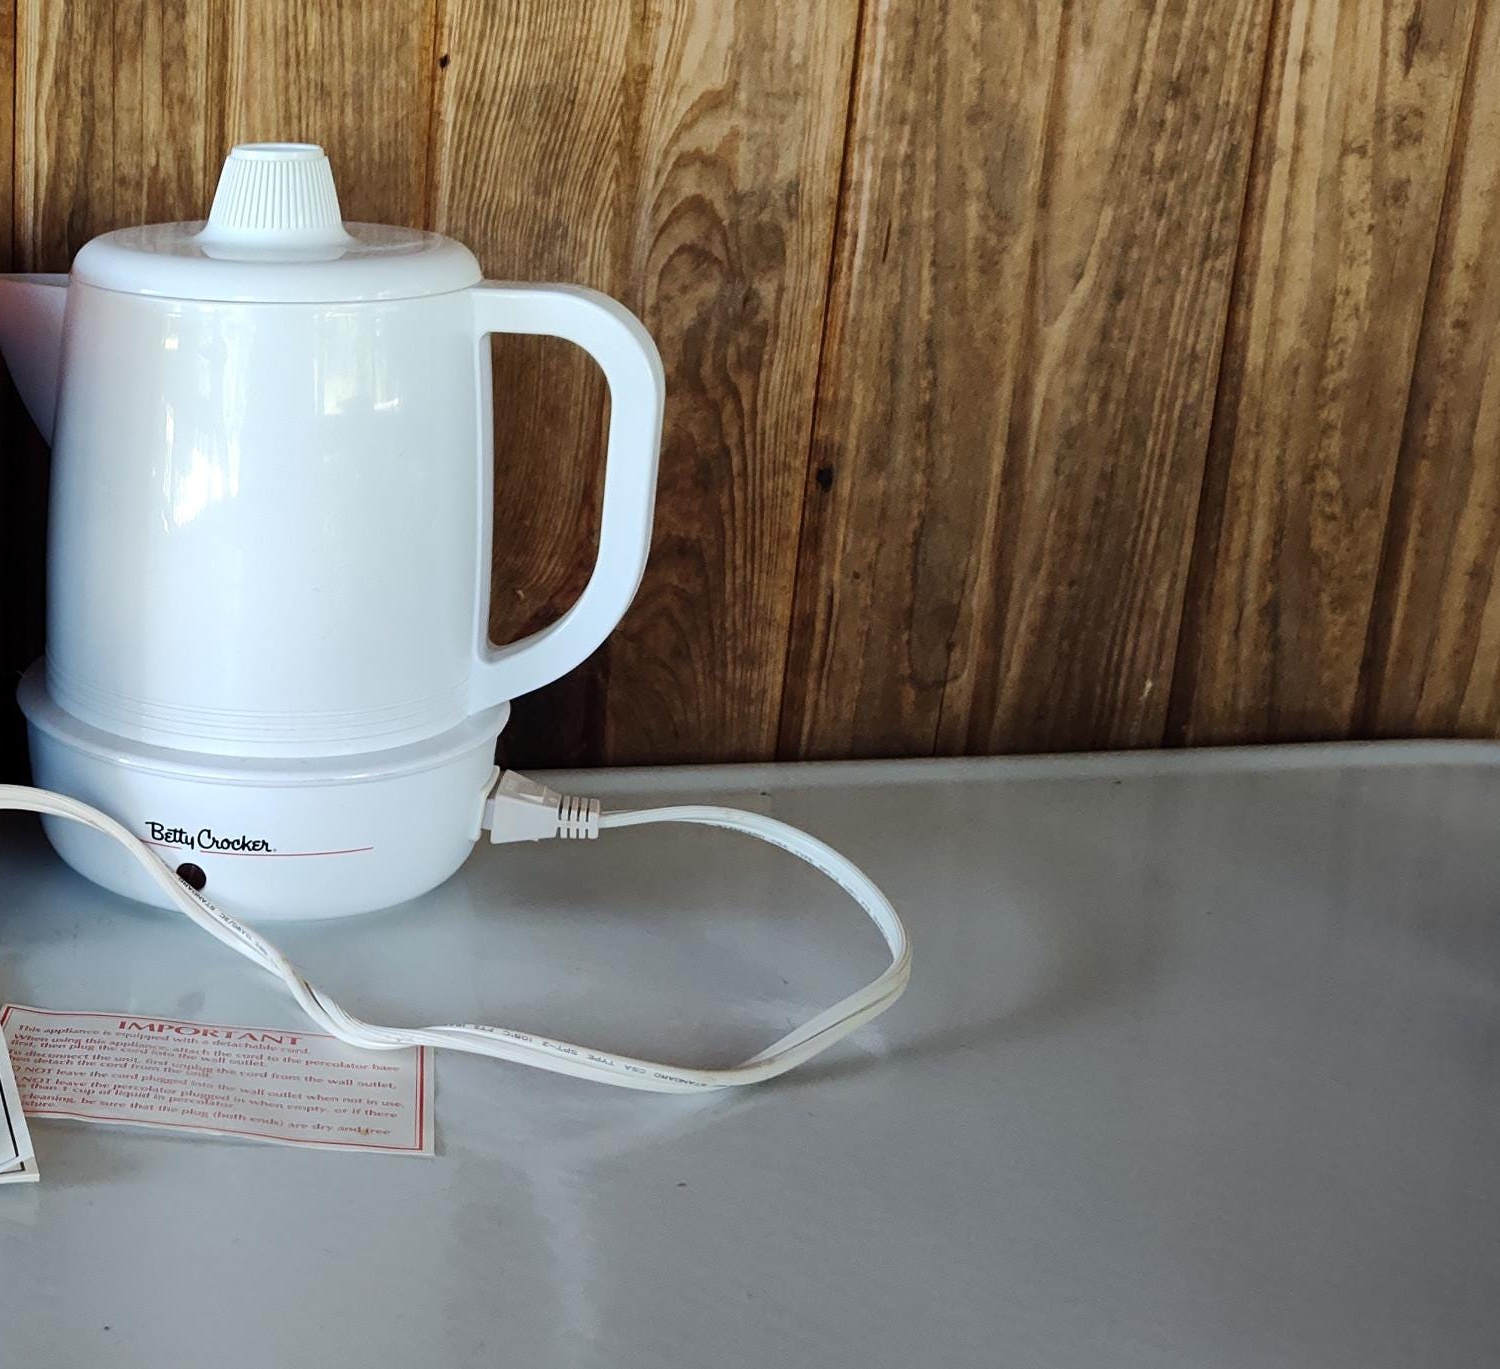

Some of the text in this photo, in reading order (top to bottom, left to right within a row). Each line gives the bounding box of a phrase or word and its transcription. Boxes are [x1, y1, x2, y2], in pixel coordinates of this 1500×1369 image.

[145, 821, 272, 852] Betty Crocker
[44, 1027, 100, 1035] appliance
[116, 1031, 170, 1041] equipped
[173, 1034, 198, 1042] with
[212, 1039, 277, 1051] detachable
[119, 1021, 304, 1046] IMPORTANT
[15, 1034, 49, 1042] When
[52, 1036, 81, 1045] using
[174, 1047, 210, 1056] attach
[305, 1060, 369, 1071] percolator
[373, 1063, 399, 1071] base
[25, 1050, 89, 1059] disconnect
[172, 1062, 213, 1073] unplug
[217, 1067, 236, 1075] the
[272, 1072, 301, 1081] from
[305, 1075, 324, 1083] the
[34, 1057, 73, 1065] detach
[131, 1063, 160, 1071] from
[69, 1042, 95, 1051] plug
[201, 1056, 226, 1064] wall
[22, 1076, 52, 1084] NOT
[56, 1078, 86, 1086] leave
[90, 1079, 109, 1087] the
[113, 1083, 176, 1095] percolator
[180, 1090, 230, 1101] plugged
[249, 1100, 283, 1109] when
[365, 1109, 398, 1118] there
[25, 1066, 52, 1074] NOT
[56, 1068, 87, 1076] leave
[90, 1070, 108, 1078] the
[141, 1075, 187, 1086] plugged
[218, 1083, 236, 1091] the
[240, 1087, 264, 1096] wall
[268, 1090, 302, 1099] outlet
[306, 1094, 339, 1102] when
[115, 1089, 150, 1099] liquid
[159, 1105, 179, 1113] the
[181, 1108, 209, 1118] plug
[312, 1123, 333, 1131] dry
[337, 1125, 361, 1133] and
